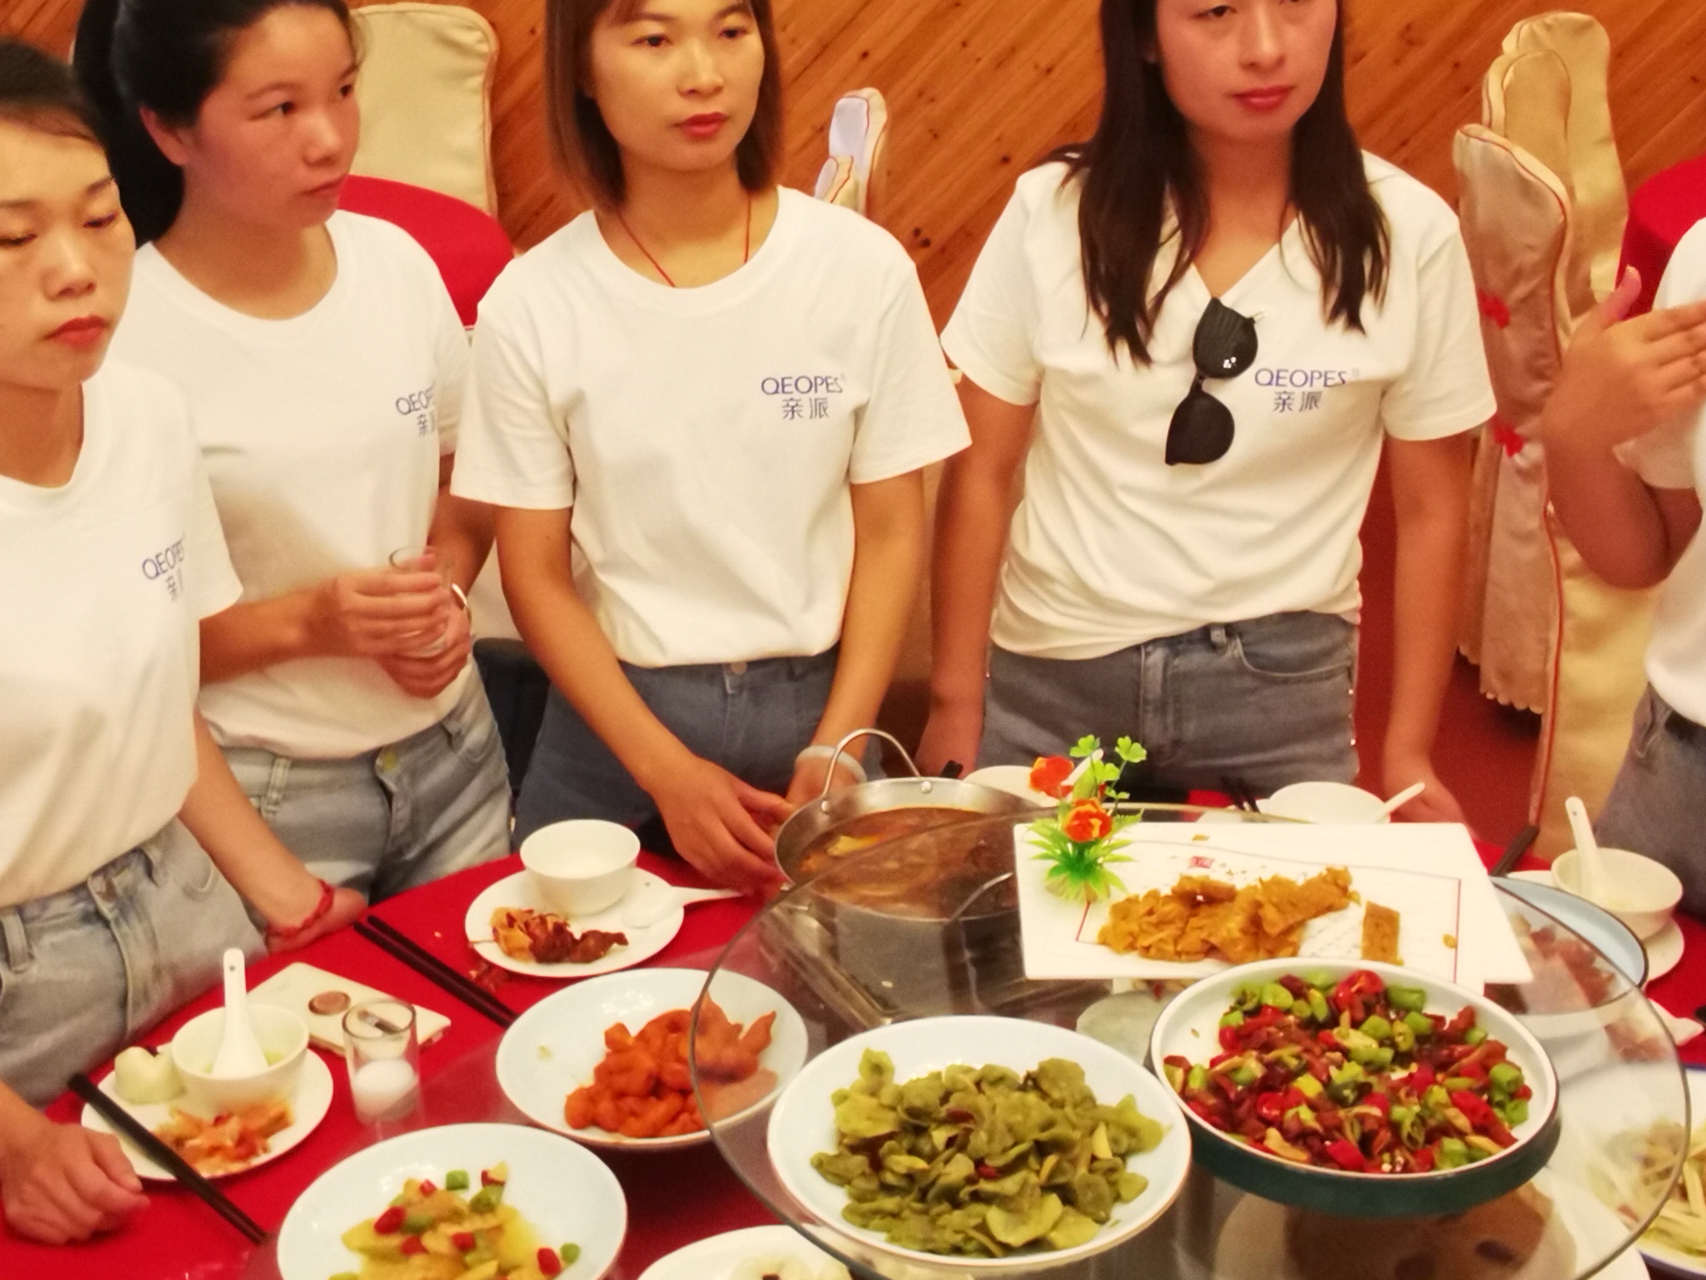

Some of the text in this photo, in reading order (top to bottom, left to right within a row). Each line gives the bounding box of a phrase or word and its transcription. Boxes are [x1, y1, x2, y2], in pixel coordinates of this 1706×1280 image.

[760, 375, 843, 396] QEOPES
[1254, 367, 1348, 388] QEOPES
[781, 397, 830, 421] 亲派
[1272, 390, 1323, 413] 亲派
